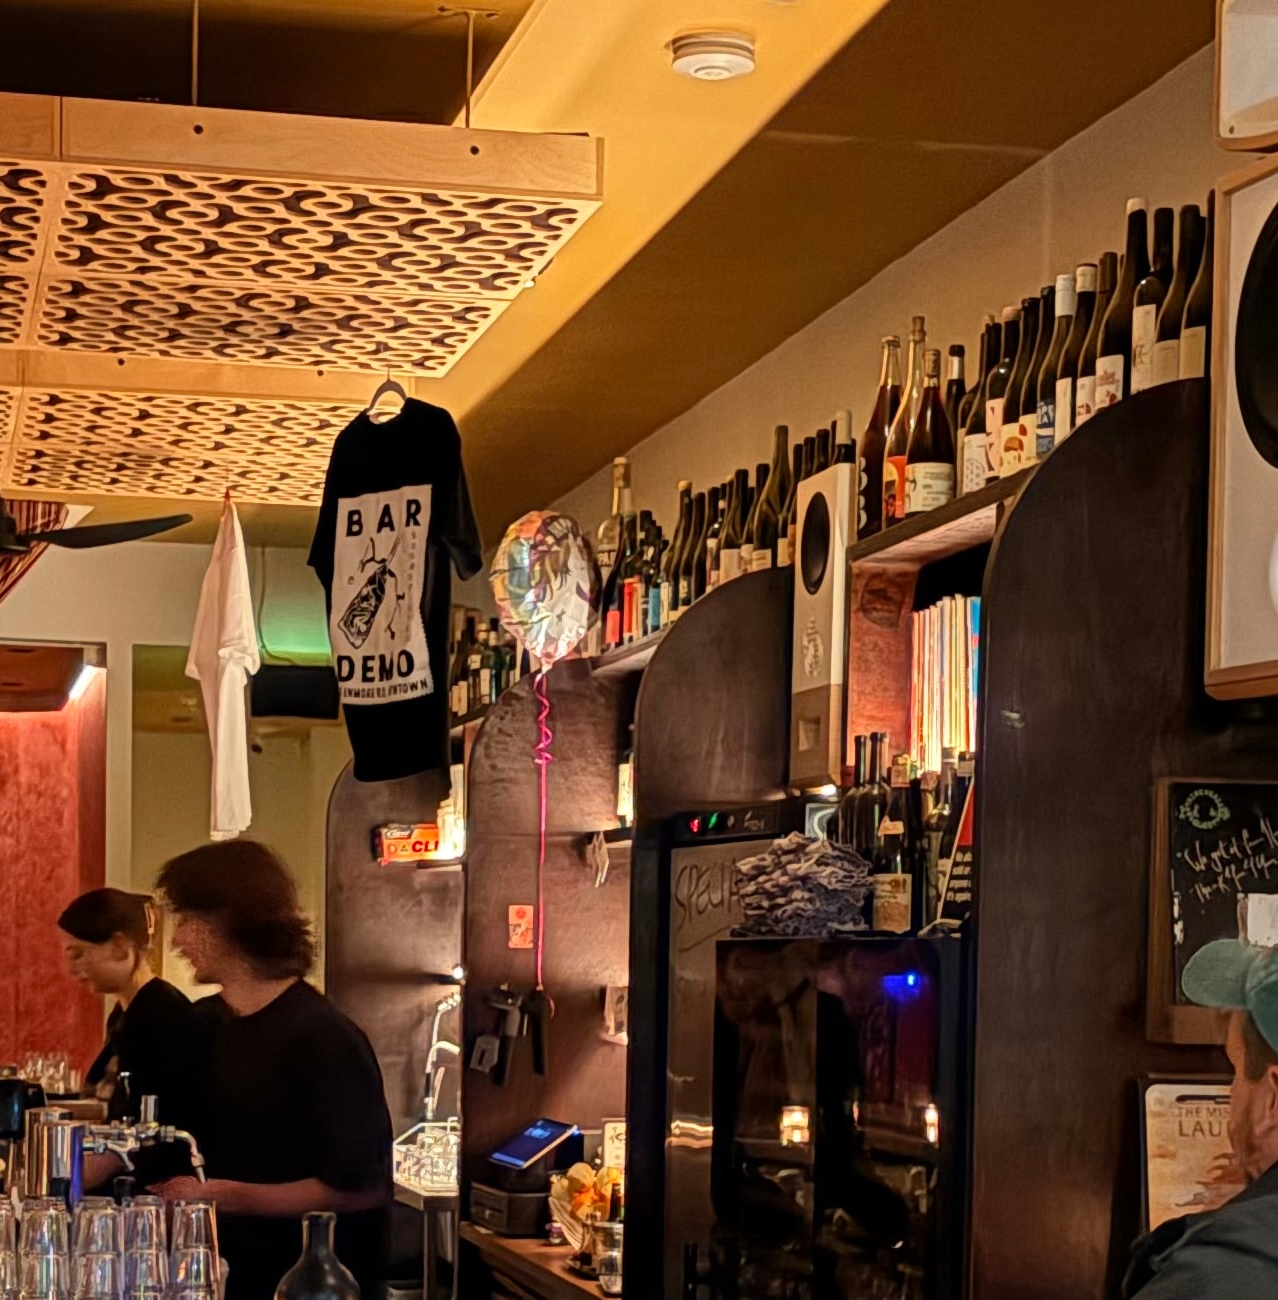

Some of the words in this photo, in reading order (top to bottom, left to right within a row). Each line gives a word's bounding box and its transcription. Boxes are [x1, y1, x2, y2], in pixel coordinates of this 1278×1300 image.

[346, 499, 422, 537] BAR
[337, 649, 414, 682] DEMO
[1177, 1106, 1202, 1119] THE
